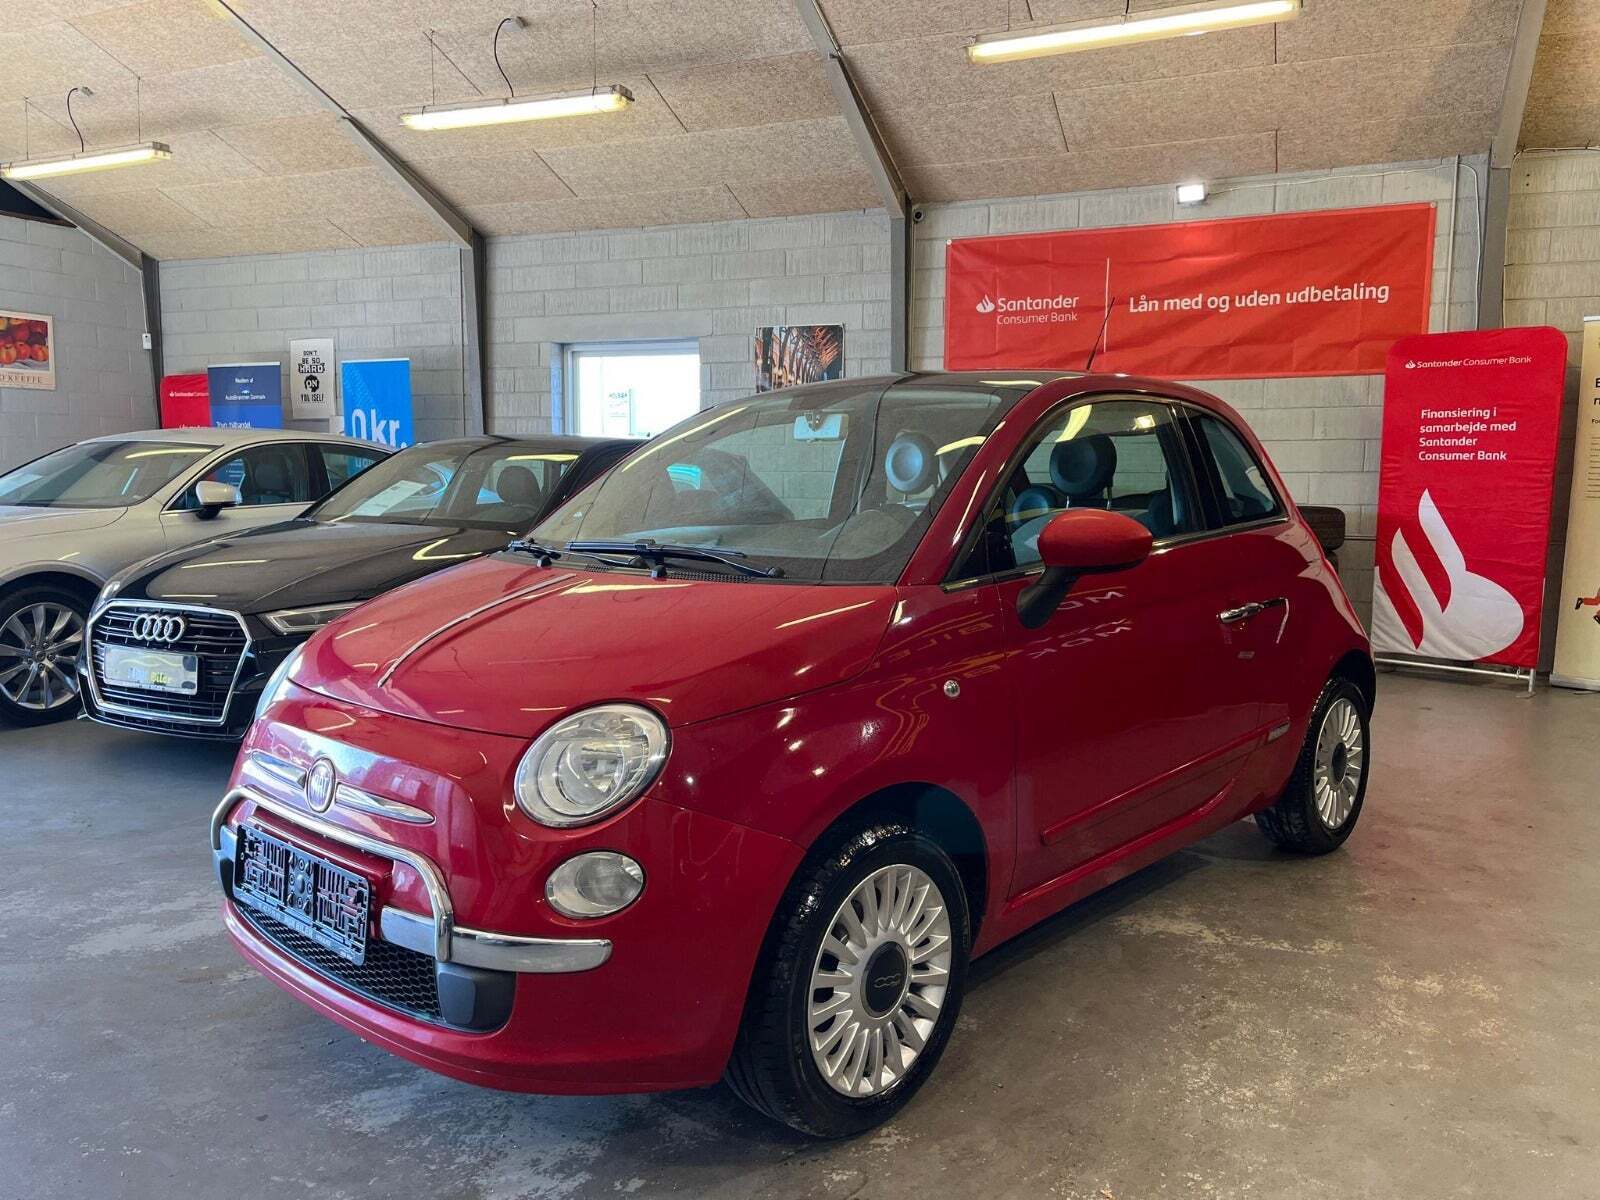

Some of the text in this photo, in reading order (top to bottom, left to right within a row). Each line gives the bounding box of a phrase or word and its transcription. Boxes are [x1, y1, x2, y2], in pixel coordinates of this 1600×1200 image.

[997, 295, 1079, 312] Santander
[1129, 284, 1390, 313] Lån med og uden udbetaling
[996, 312, 1078, 325] Consumer Bank
[1417, 356, 1532, 369] Santander Consumer Bank
[1421, 407, 1497, 419] Finansiering i
[1420, 421, 1516, 434] samarbejde med
[1419, 437, 1478, 446] Santander
[1419, 451, 1507, 460] Consumer Bank
